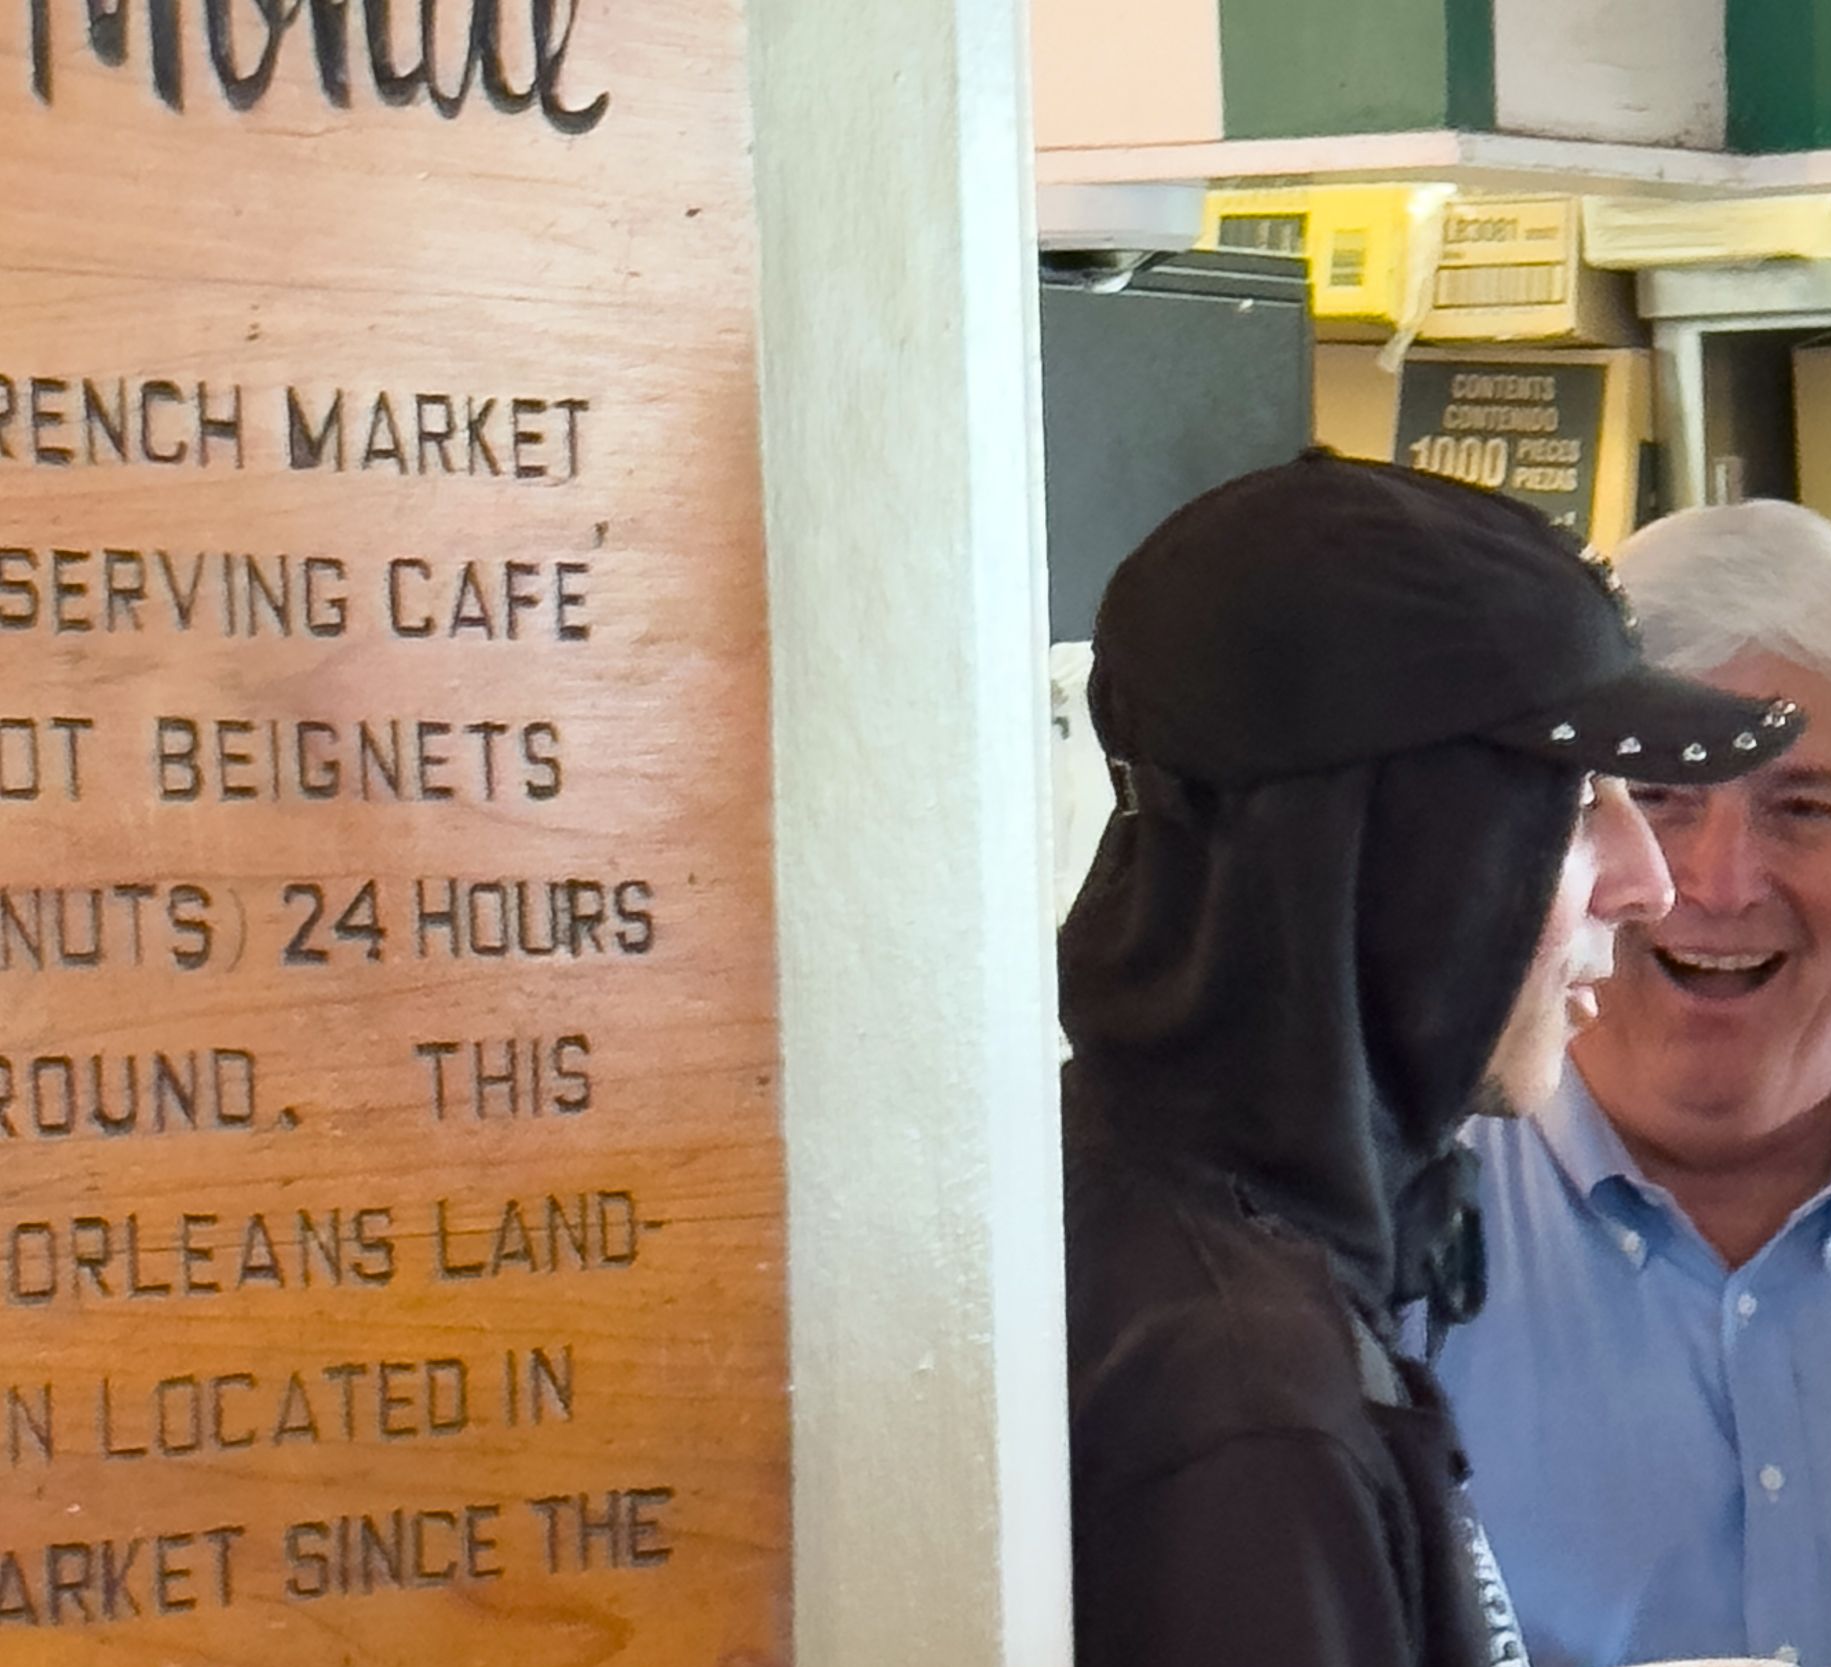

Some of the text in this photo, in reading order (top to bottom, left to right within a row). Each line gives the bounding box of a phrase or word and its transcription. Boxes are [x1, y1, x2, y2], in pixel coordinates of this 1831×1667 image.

[1451, 373, 1556, 401] CONTENTS
[287, 386, 590, 480] MARKET
[1409, 435, 1508, 489] 1000
[0, 547, 348, 639] SERVING
[156, 715, 563, 802] BEIGNETS
[282, 877, 386, 967] 24
[415, 877, 656, 957] HOURS
[416, 1033, 592, 1124] THIS
[8, 1188, 666, 1306] ORLEANS LAND-
[100, 1356, 470, 1461] LOCATED
[505, 1344, 574, 1427] IN
[0, 1486, 676, 1627] ARKET SINCE THE
